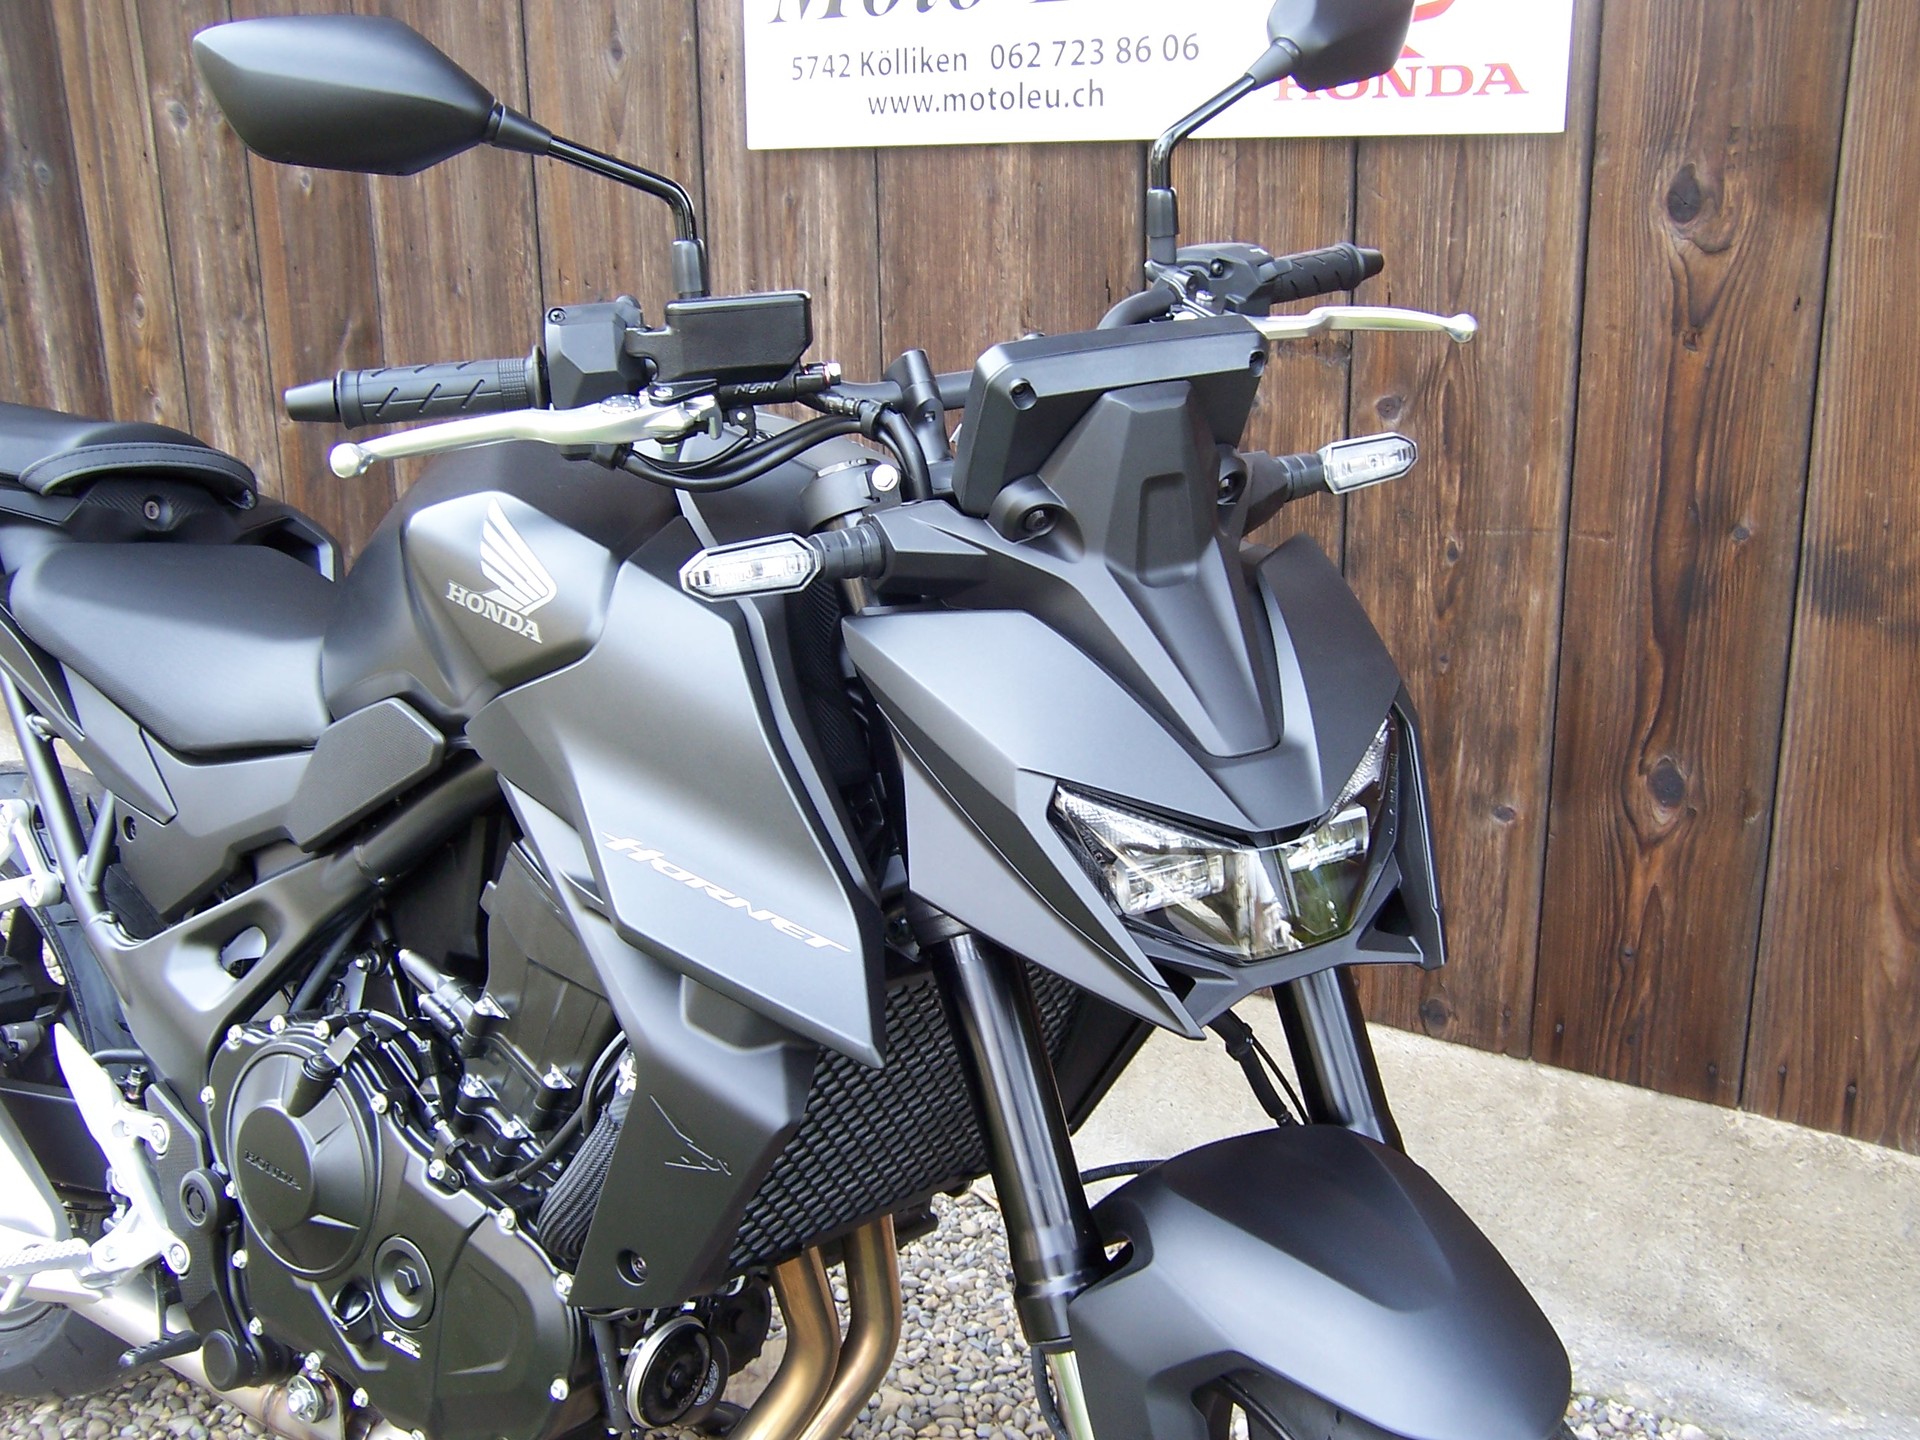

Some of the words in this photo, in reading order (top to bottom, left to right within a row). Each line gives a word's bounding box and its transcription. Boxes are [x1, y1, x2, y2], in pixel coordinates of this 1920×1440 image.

[793, 54, 850, 80] 5742
[861, 47, 966, 76] Kölliken
[991, 42, 1040, 69] 062
[1053, 39, 1103, 66] 723
[1116, 36, 1151, 63] 86
[1163, 33, 1199, 61] 06
[868, 79, 1103, 114] www.motoleu.ch
[445, 582, 543, 644] HONDA
